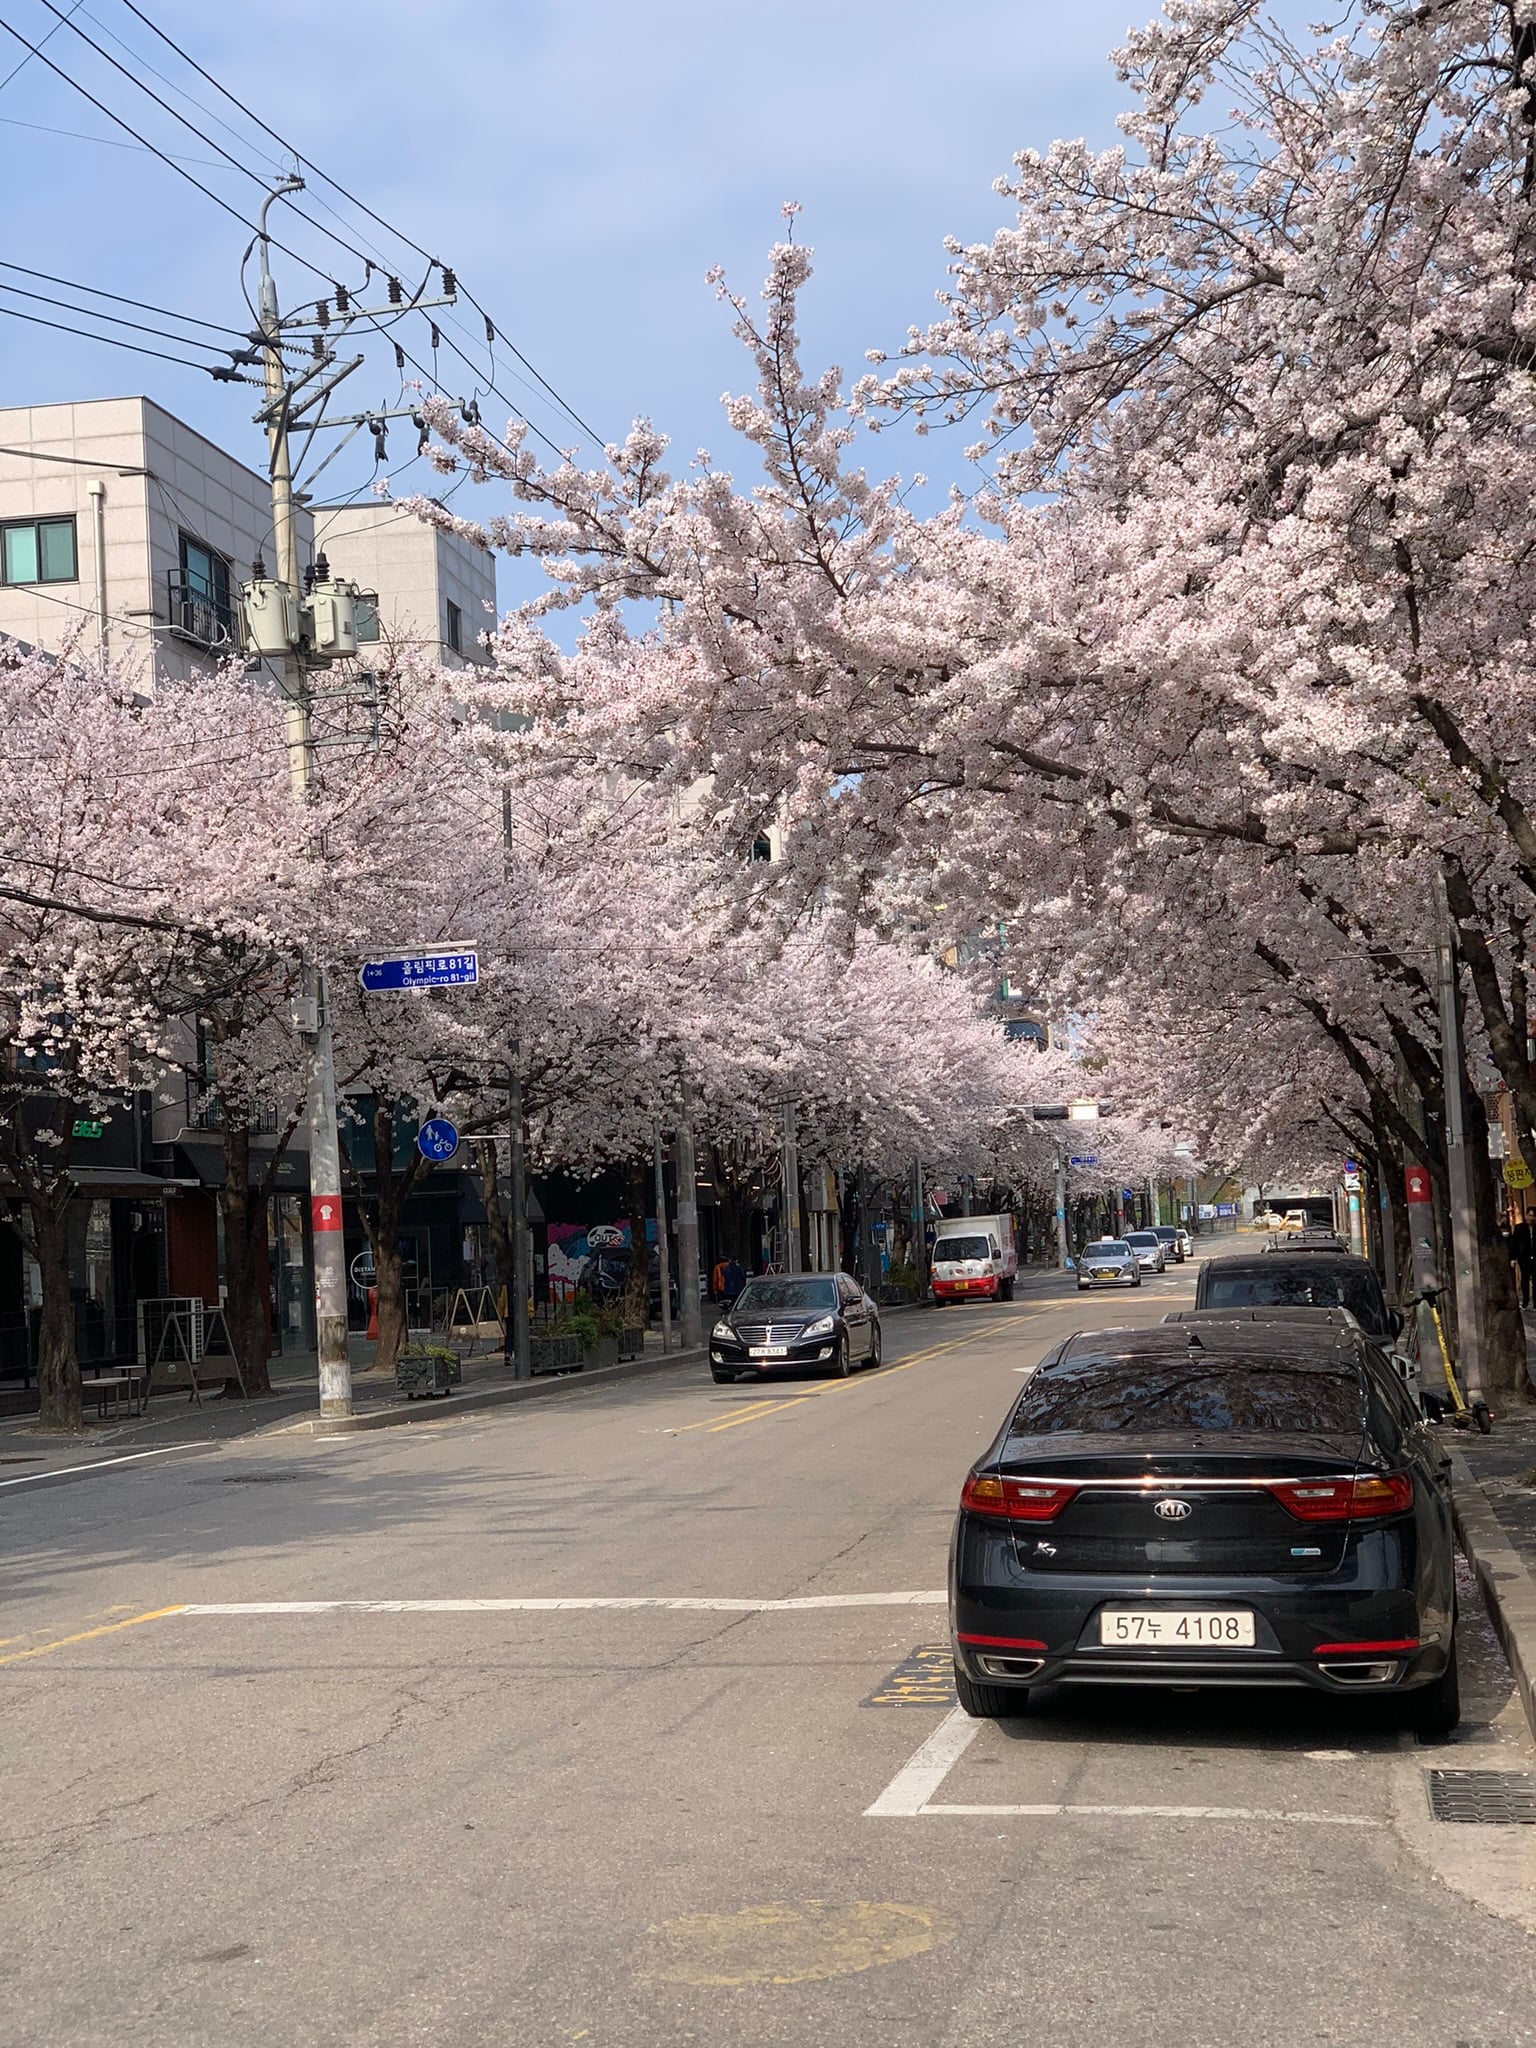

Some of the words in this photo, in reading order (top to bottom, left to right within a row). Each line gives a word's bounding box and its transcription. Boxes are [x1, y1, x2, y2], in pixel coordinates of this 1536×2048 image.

[402, 956, 474, 975] 올림픽로81길
[402, 975, 449, 986] Olympic-ro
[450, 972, 475, 982] 81-gil
[1160, 1502, 1186, 1516] KIA
[1116, 1617, 1163, 1640] 57누
[1175, 1617, 1240, 1640] 4108
